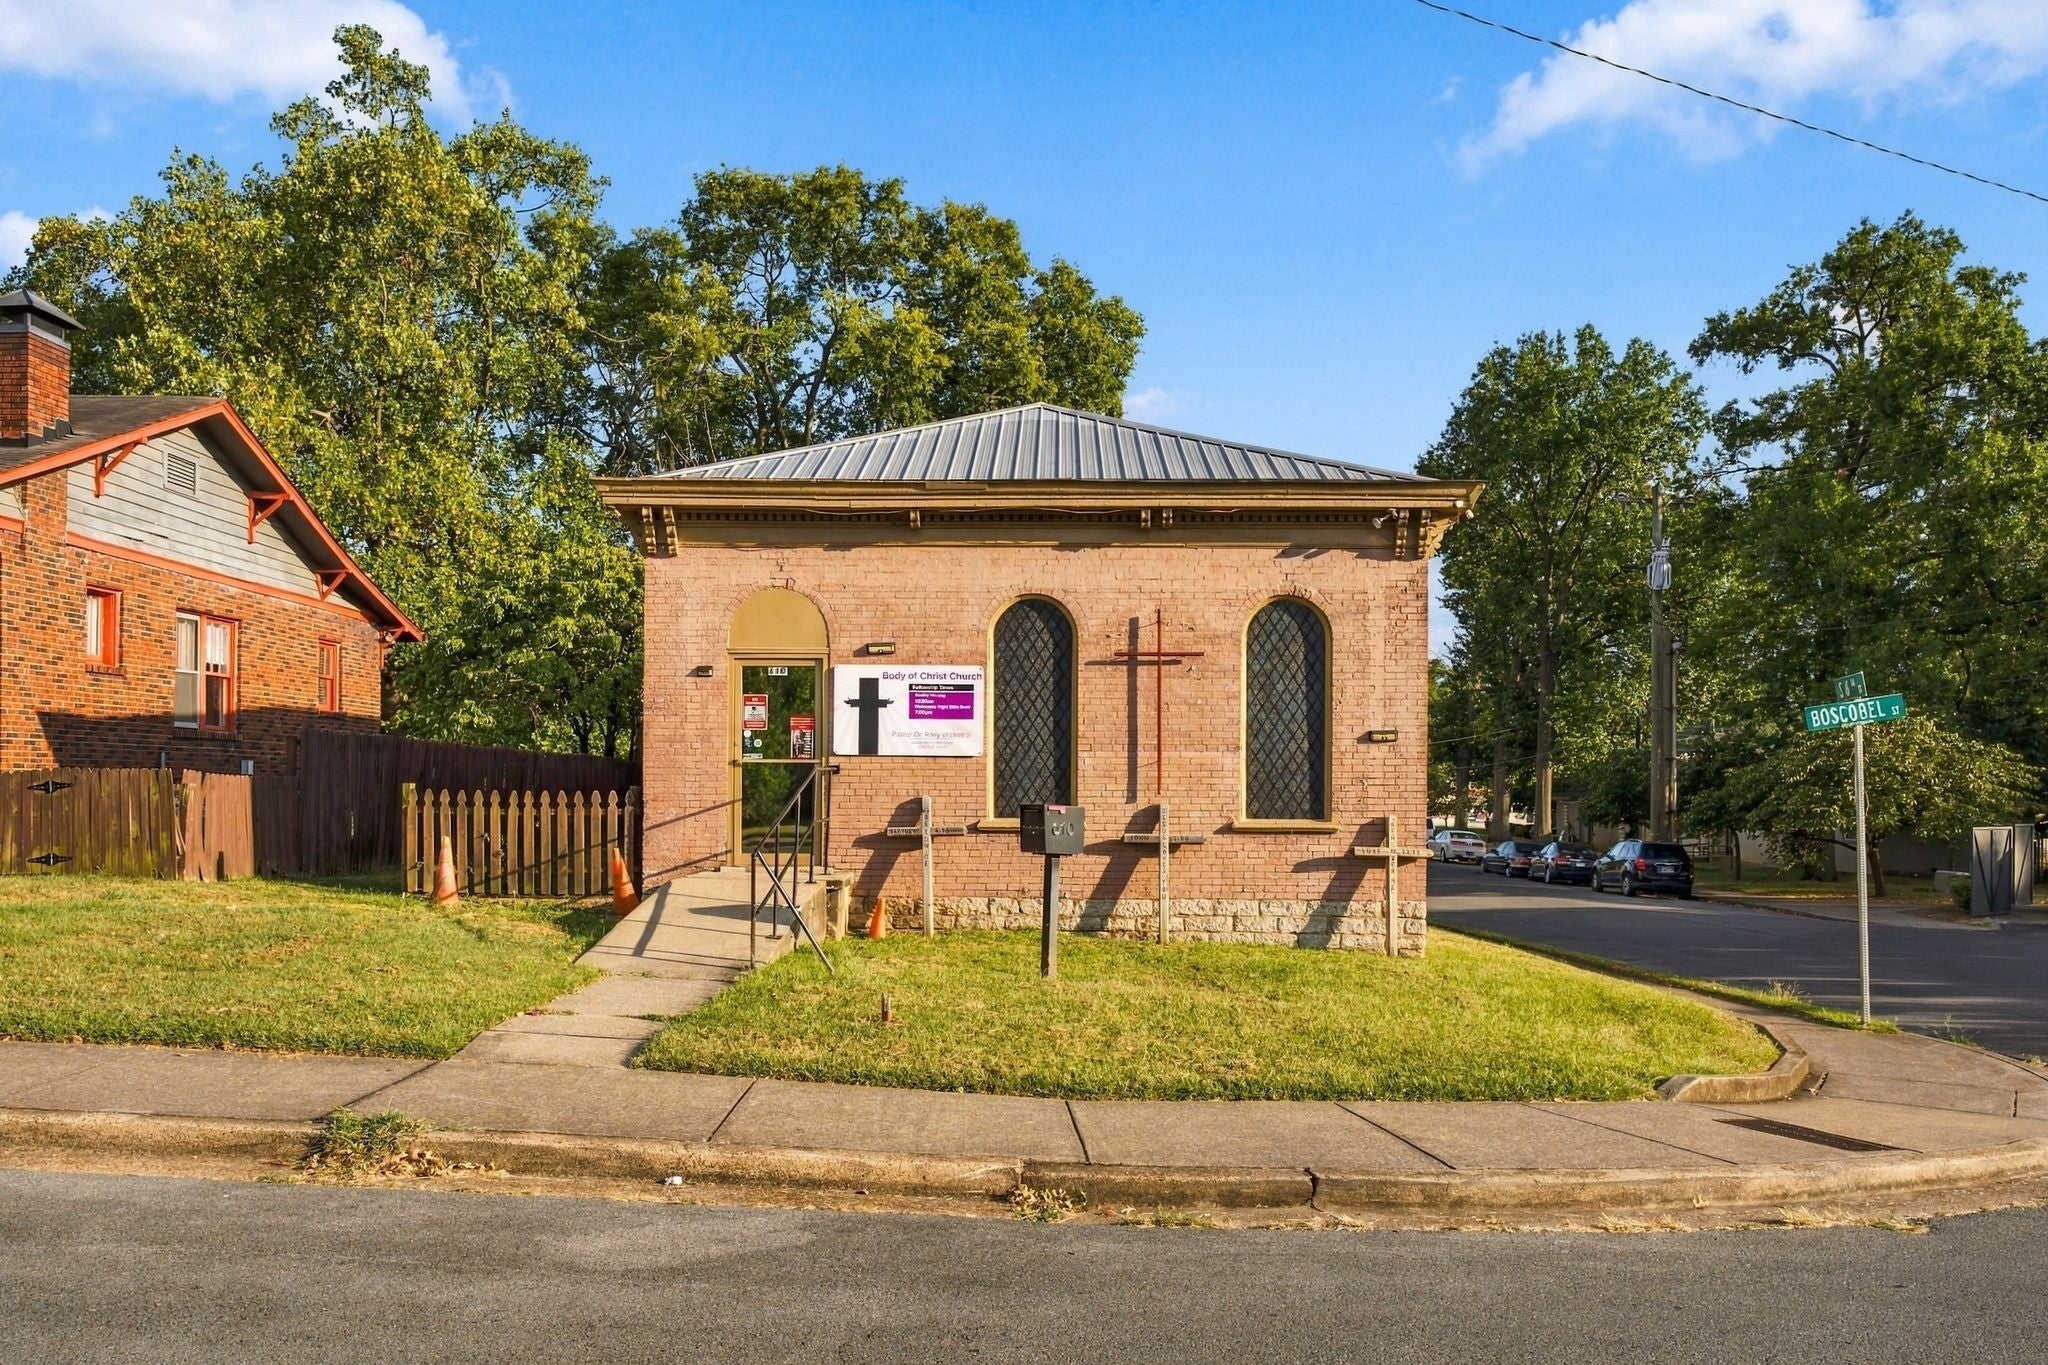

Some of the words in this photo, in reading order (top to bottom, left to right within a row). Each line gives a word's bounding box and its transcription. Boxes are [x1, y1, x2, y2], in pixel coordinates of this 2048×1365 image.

[882, 671, 906, 681] Body
[908, 671, 917, 680] of
[919, 671, 947, 680] Christ
[949, 672, 982, 681] Church
[1810, 700, 1886, 728] BOSCOBEL
[1891, 705, 1900, 716] ST
[924, 731, 940, 740] Riley
[1051, 822, 1074, 837] 610
